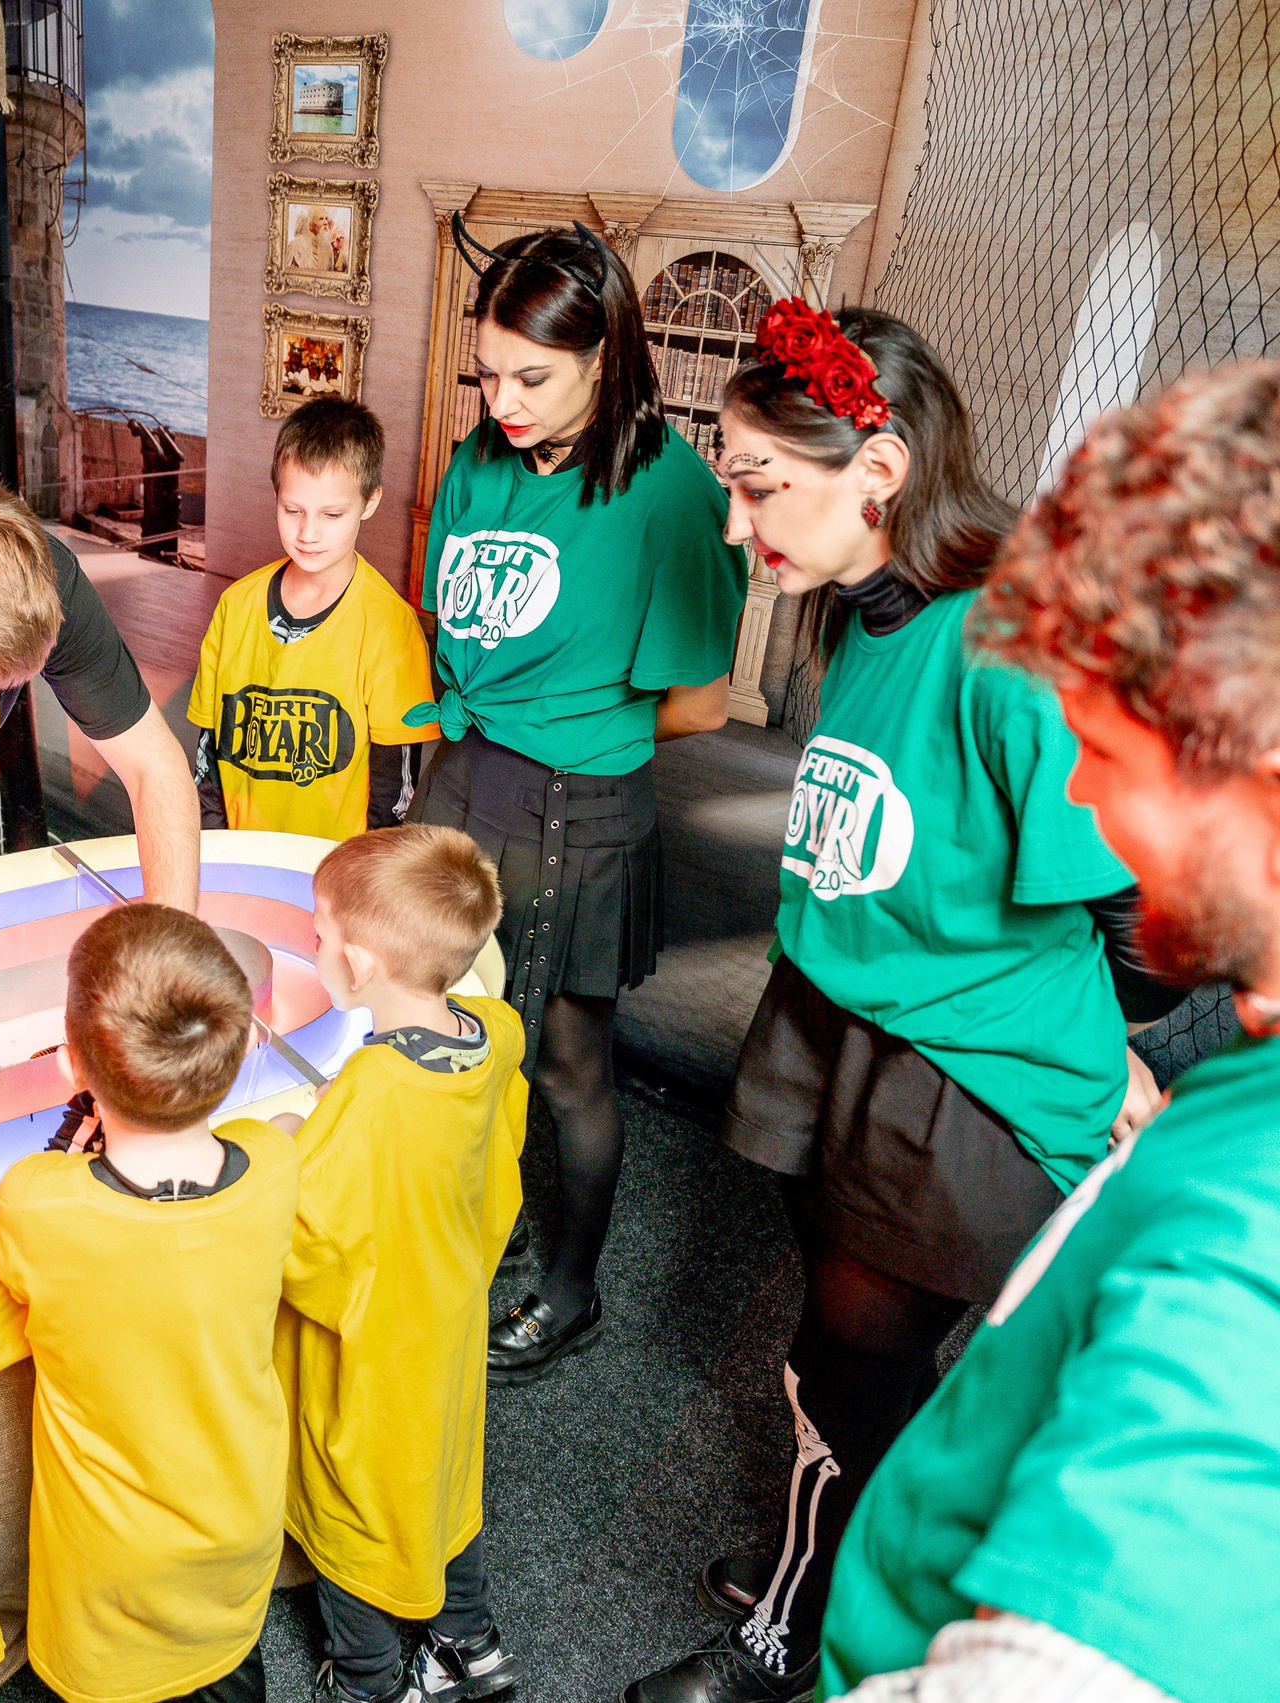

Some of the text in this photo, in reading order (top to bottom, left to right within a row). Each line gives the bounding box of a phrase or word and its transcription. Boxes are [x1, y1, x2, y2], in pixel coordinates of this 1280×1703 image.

[436, 530, 561, 640] BOYRD
[217, 684, 356, 782] BOYARD
[253, 696, 311, 717] FORT
[293, 765, 316, 784] 2.0
[801, 752, 861, 793] FORT
[781, 735, 915, 896] OYARD
